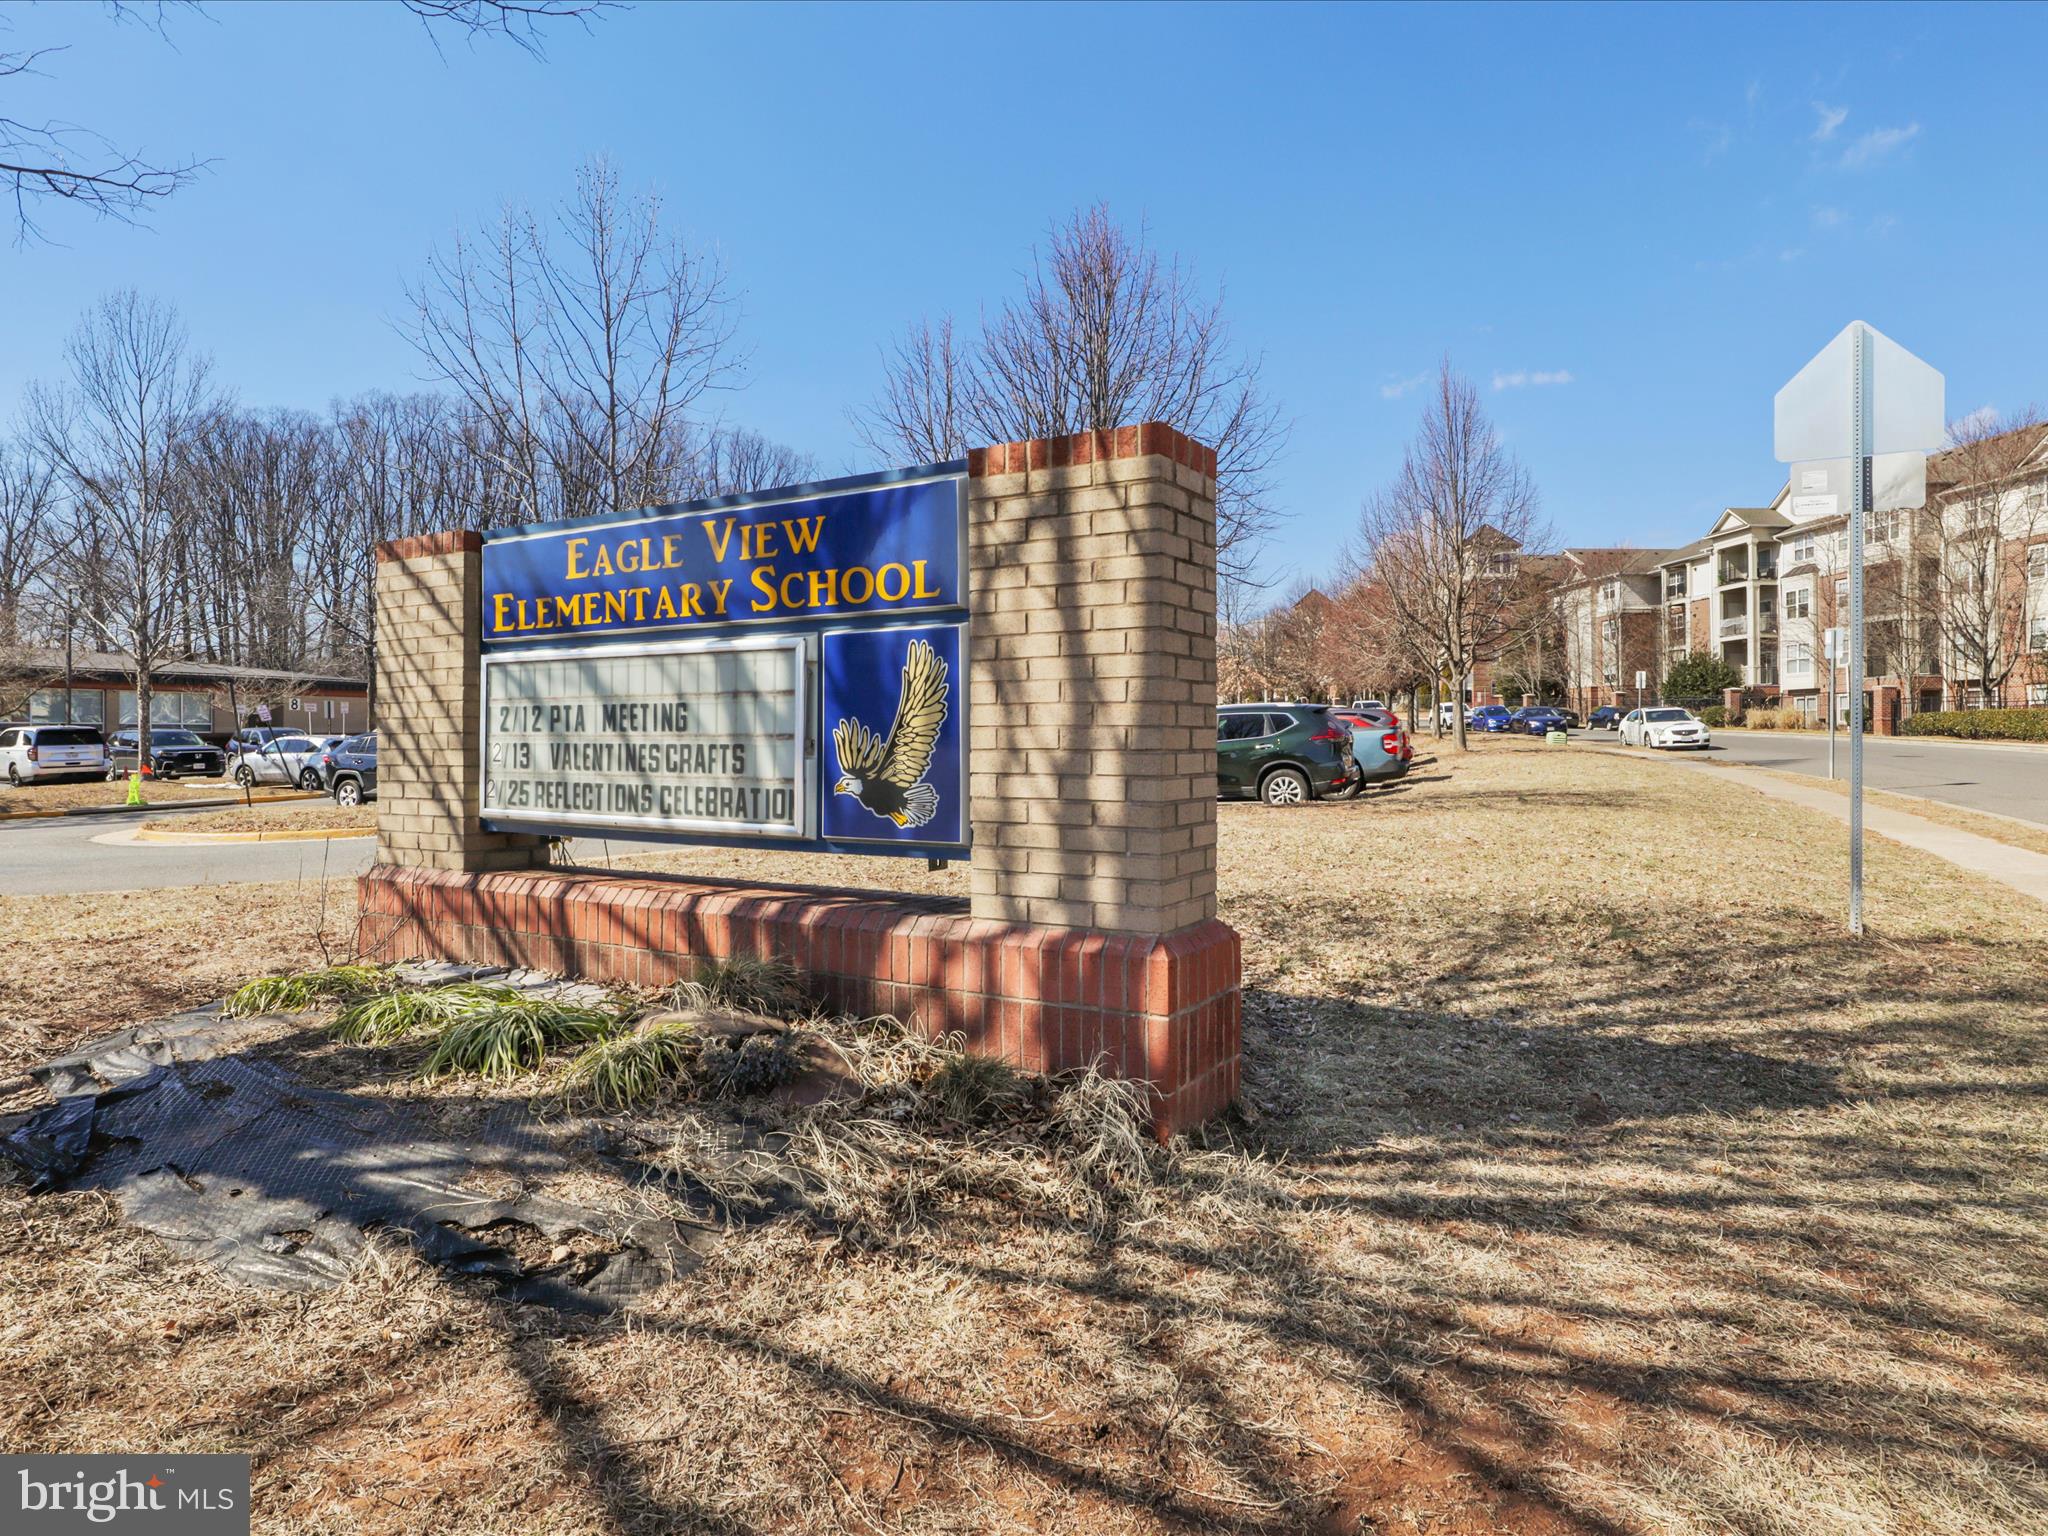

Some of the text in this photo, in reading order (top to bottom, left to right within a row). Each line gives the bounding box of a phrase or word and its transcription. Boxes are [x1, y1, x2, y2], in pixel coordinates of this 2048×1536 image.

[291, 698, 298, 710] 8
[500, 702, 688, 732] 2/12 PTA MEETING
[492, 742, 530, 769] 2/13
[486, 779, 530, 806] 2/25
[534, 780, 652, 814] REFLECTIONS
